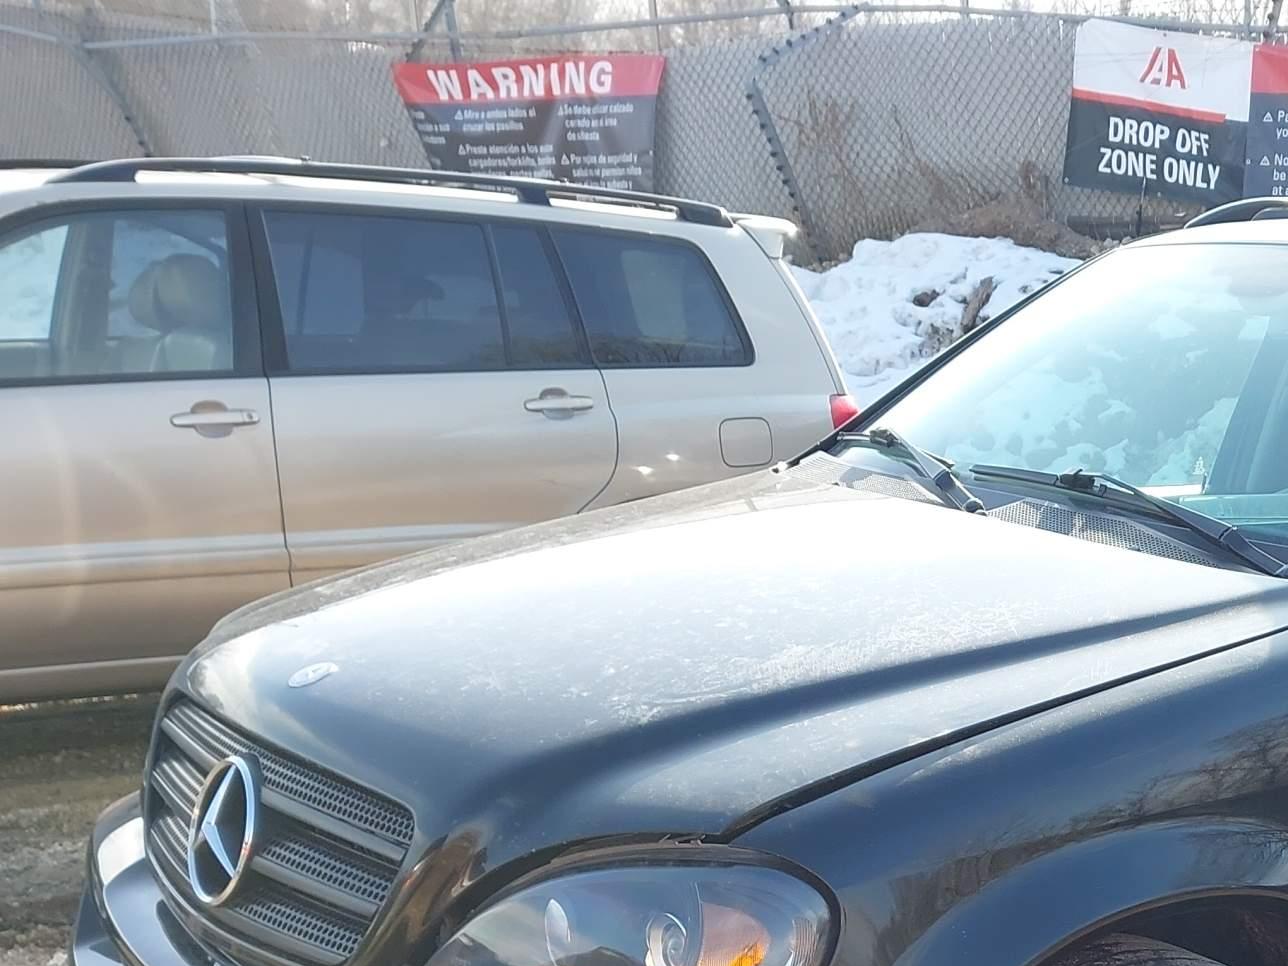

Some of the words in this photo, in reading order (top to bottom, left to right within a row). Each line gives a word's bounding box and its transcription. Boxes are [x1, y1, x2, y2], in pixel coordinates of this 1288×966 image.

[427, 60, 613, 101] WARNING
[1108, 116, 1170, 149] DROP
[1175, 127, 1210, 158] OFF
[1098, 147, 1158, 180] ZONE
[1163, 156, 1221, 190] ONLY
[1272, 169, 1286, 181] be
[1272, 186, 1283, 196] at
